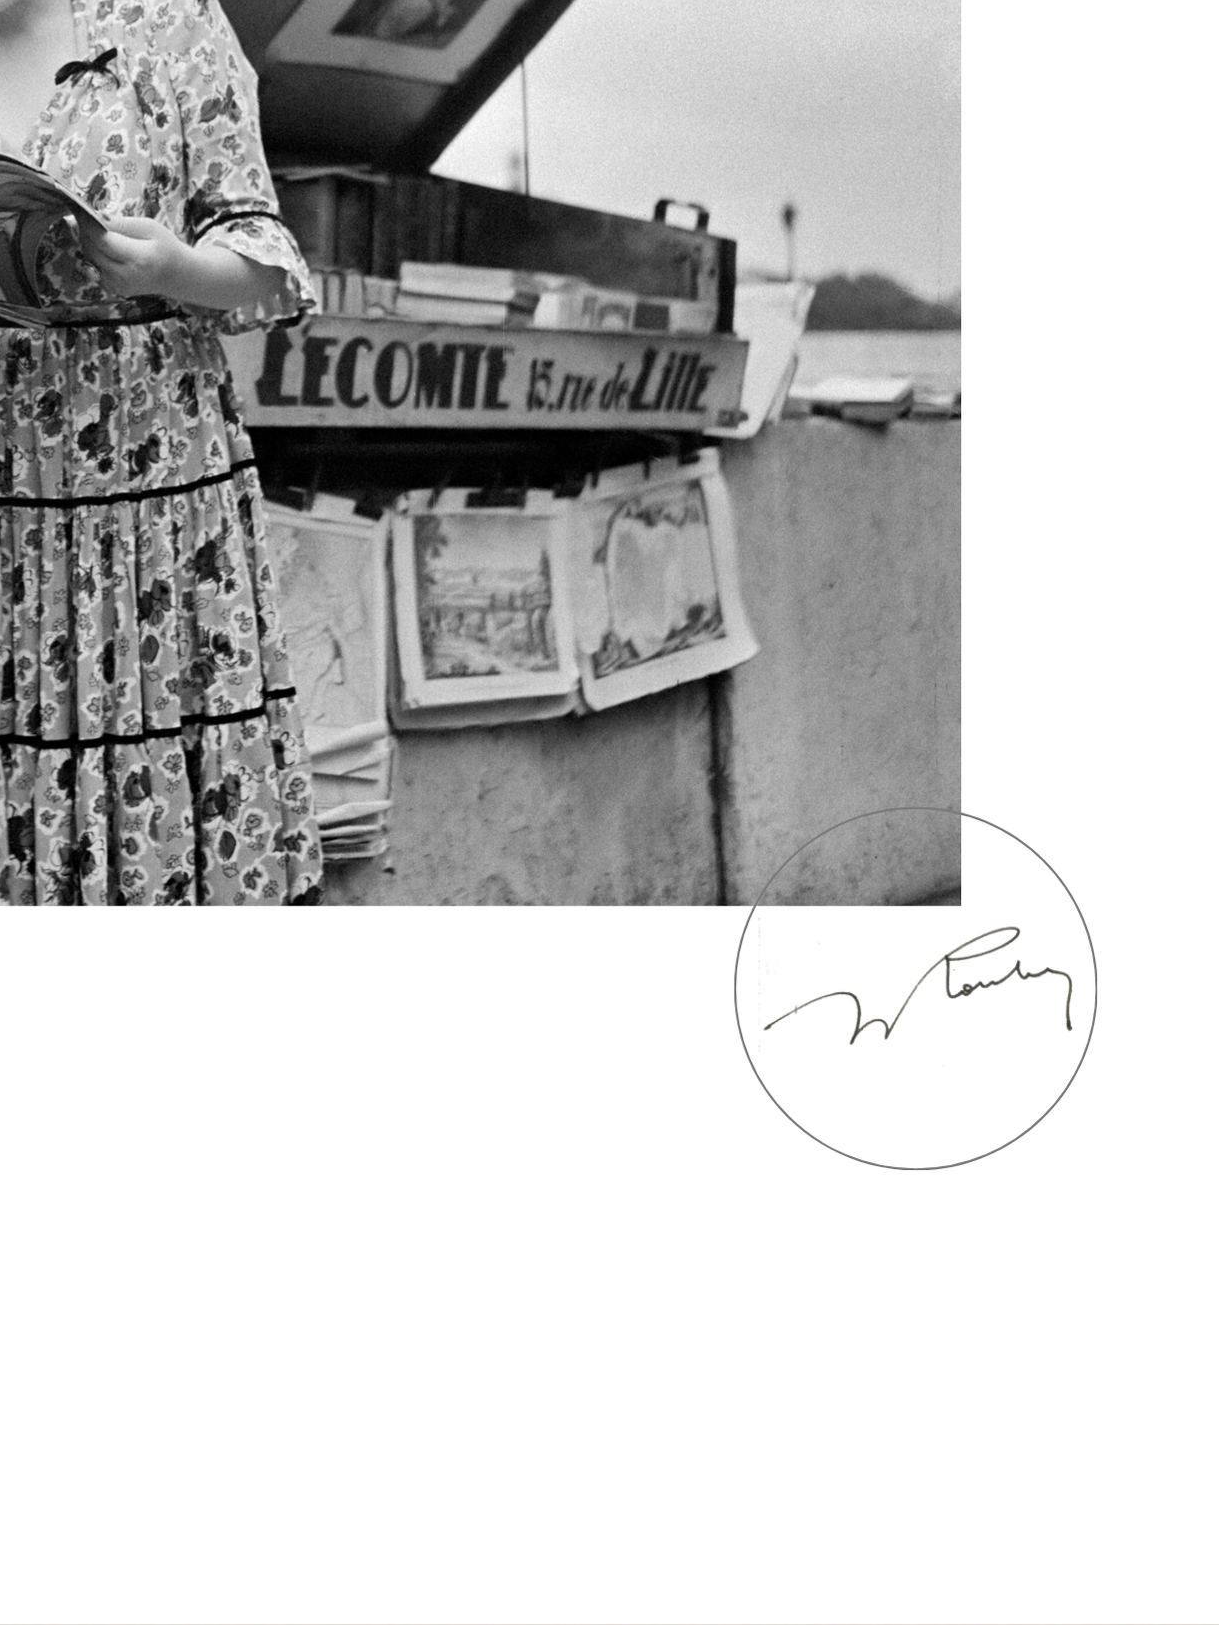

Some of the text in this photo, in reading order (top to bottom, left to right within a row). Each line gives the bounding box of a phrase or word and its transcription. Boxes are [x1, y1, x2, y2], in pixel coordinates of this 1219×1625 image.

[254, 325, 515, 411] LECOMTE
[556, 372, 597, 412] rue
[599, 361, 631, 413] de
